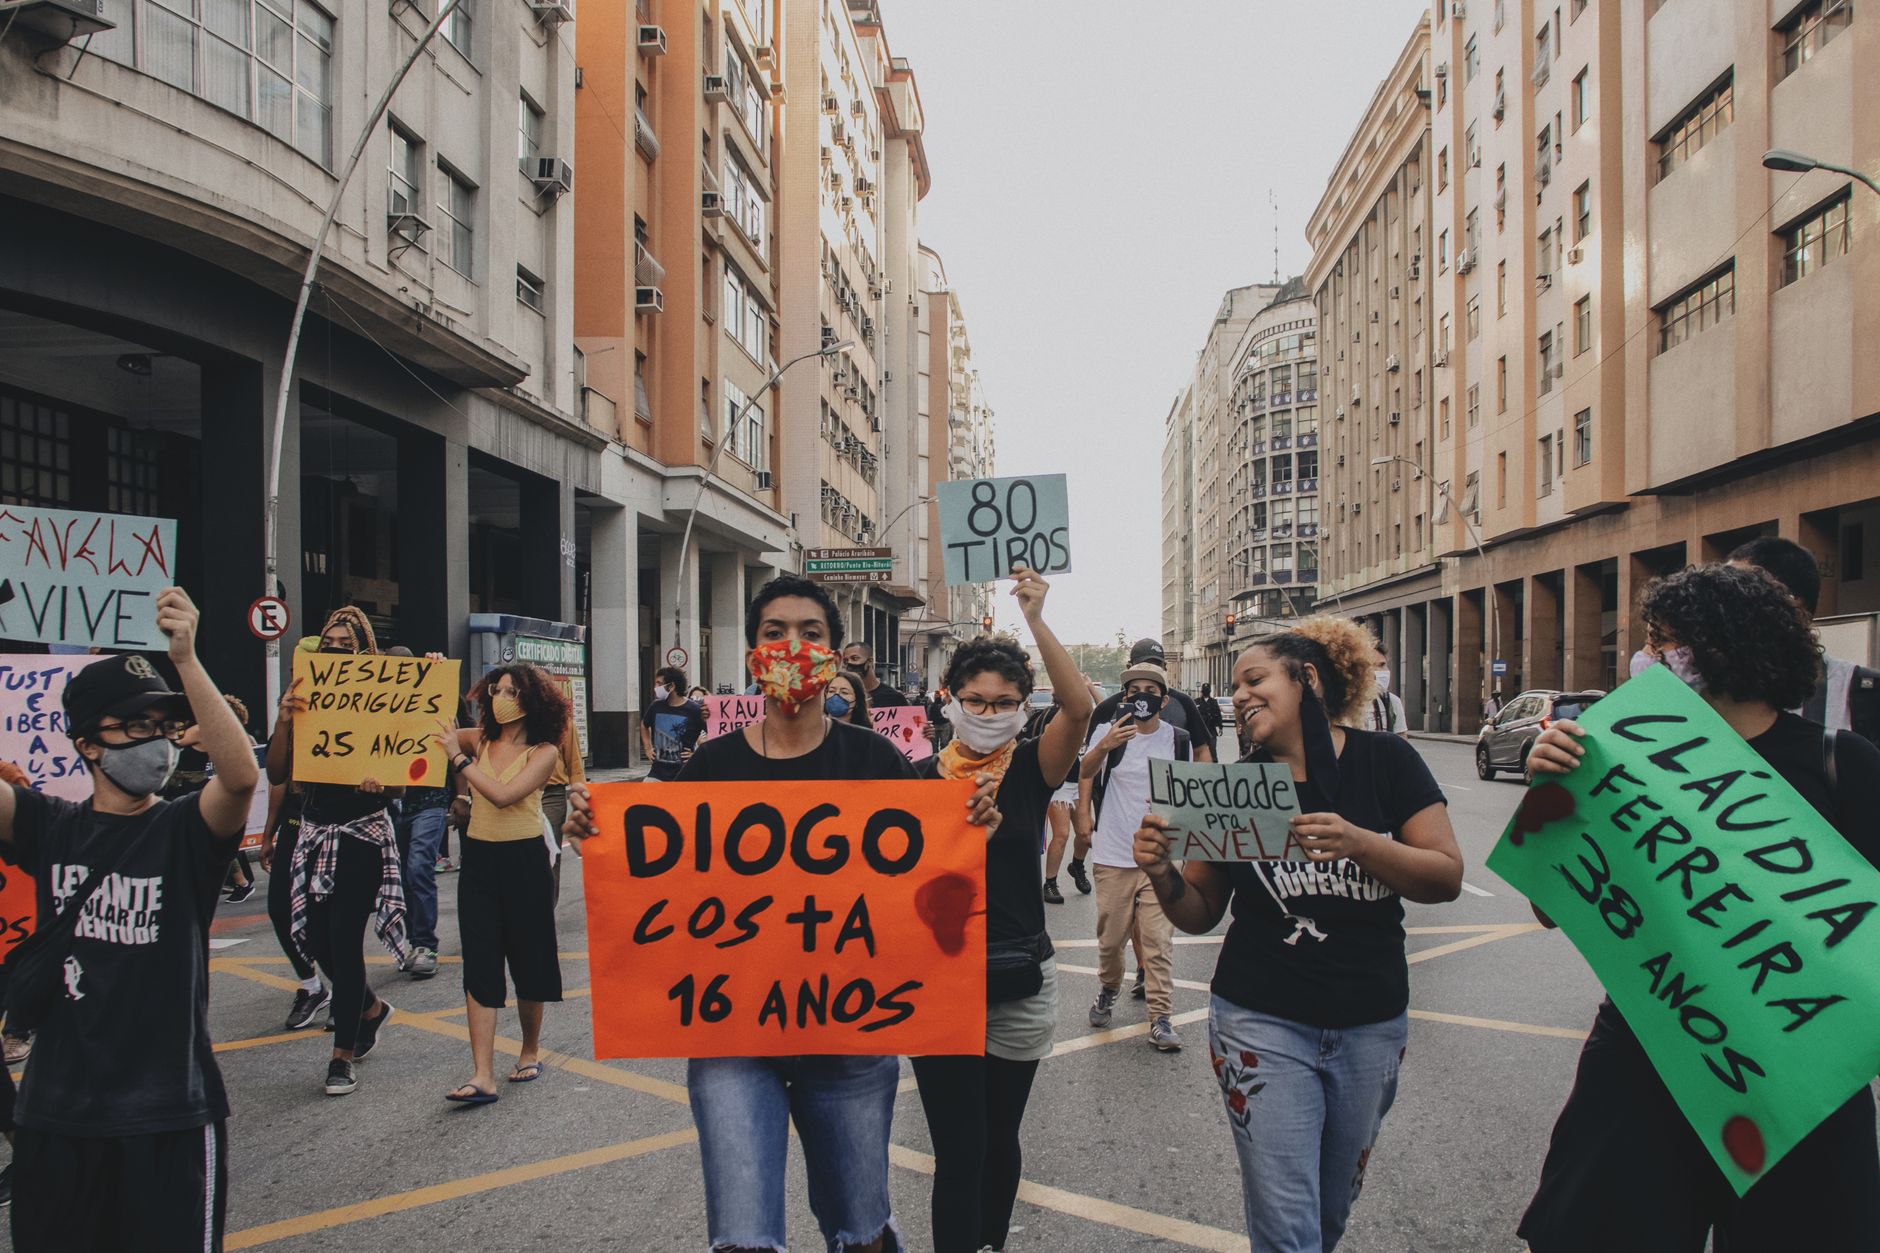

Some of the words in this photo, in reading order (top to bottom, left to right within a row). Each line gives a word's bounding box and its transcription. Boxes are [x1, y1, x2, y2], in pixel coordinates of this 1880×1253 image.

[967, 479, 1037, 537] 80
[947, 526, 1069, 581] TIROS
[20, 581, 150, 645] VIVE
[261, 605, 277, 631] E
[518, 641, 560, 661] CERTIFICADO
[561, 646, 584, 664] DIGITAL
[309, 659, 432, 689] WESLEY
[27, 692, 44, 713] E
[308, 690, 442, 714] RODRIGUES
[869, 708, 898, 723] ON
[29, 735, 49, 754] A
[311, 729, 355, 759] 25
[370, 731, 431, 759] ANOS
[876, 723, 900, 738] OR
[1148, 759, 1295, 810] Liberdade
[624, 802, 924, 878] DIOGO
[1204, 812, 1247, 831] pra
[1610, 714, 1878, 948] CLÁUDIA
[1552, 833, 1645, 939] 38
[1588, 763, 1849, 1033] FERREIRA
[667, 973, 733, 1027] 16
[757, 972, 924, 1033] ANOS
[1639, 951, 1766, 1095] ANOS
